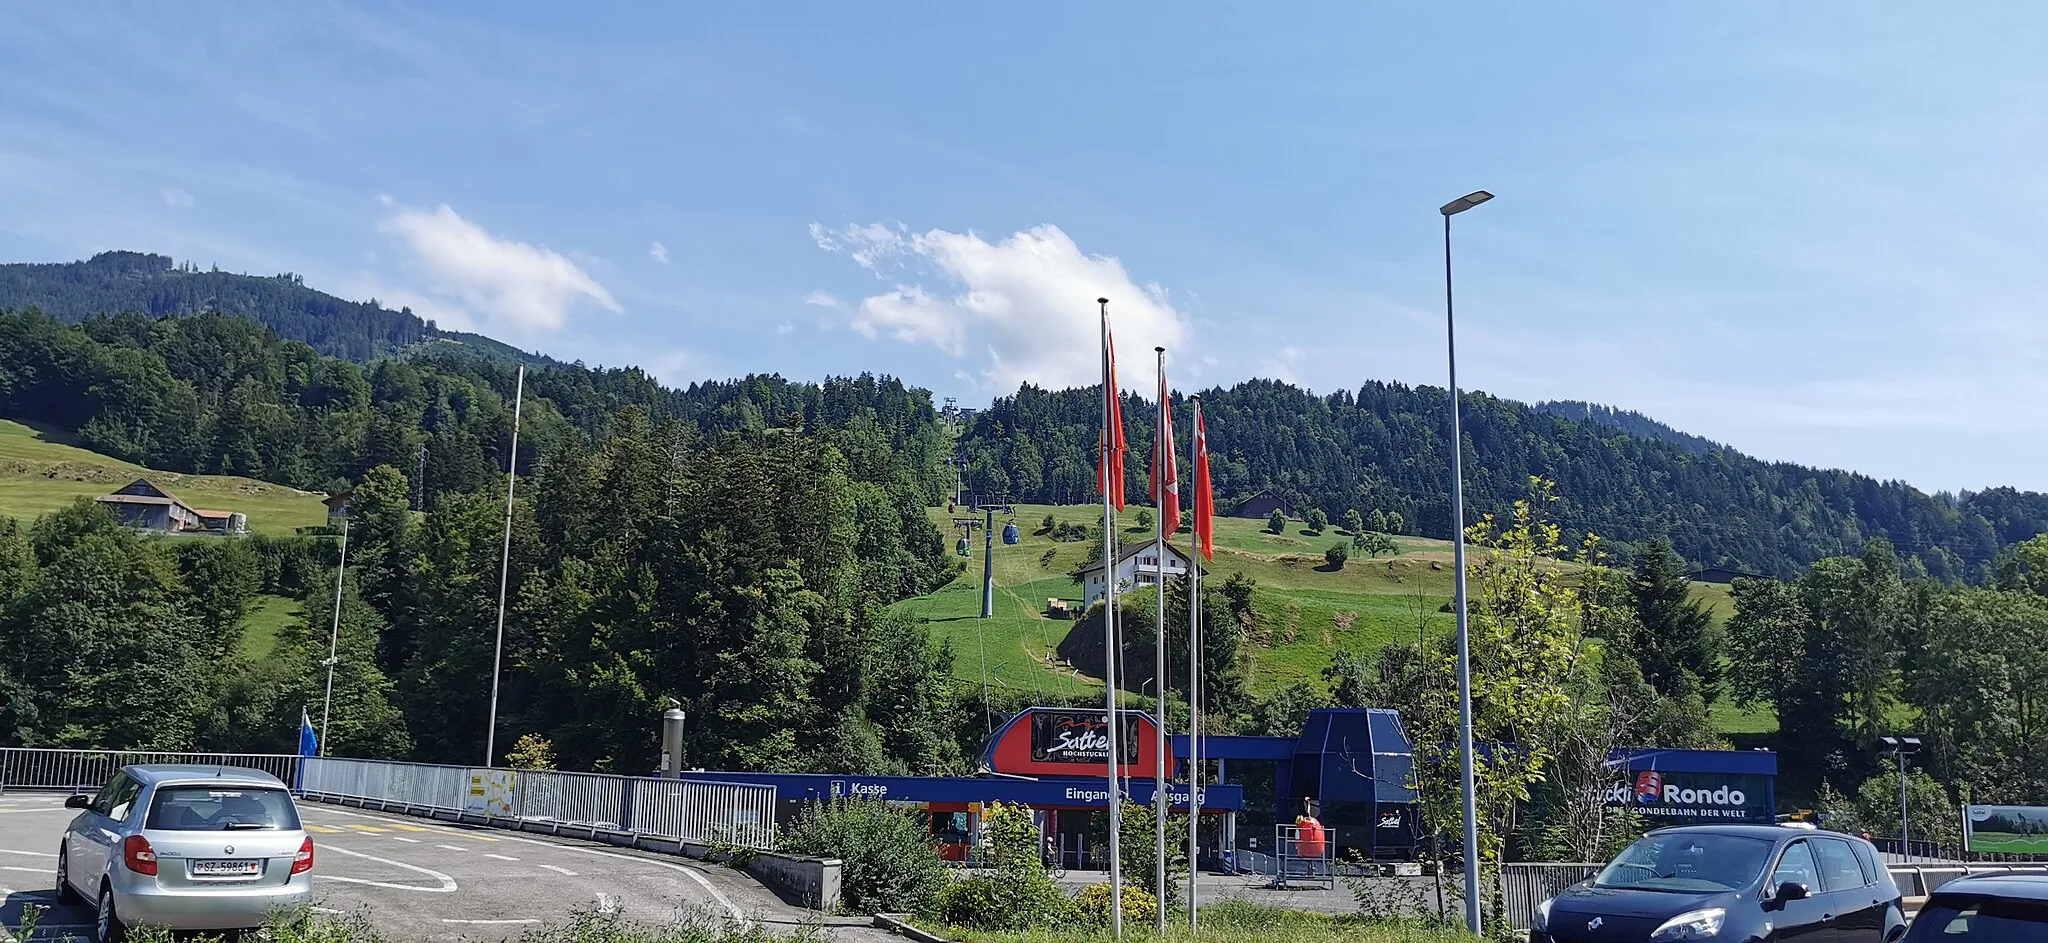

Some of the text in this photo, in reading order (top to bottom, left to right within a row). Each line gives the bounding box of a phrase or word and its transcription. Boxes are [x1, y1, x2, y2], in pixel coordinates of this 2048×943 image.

[1047, 730, 1109, 753] Satte
[851, 782, 887, 794] Kasse
[1066, 788, 1110, 802] Eingan
[1663, 784, 1745, 806] Rondo
[1150, 790, 1206, 805] Asgag
[1700, 808, 1720, 817] DER
[1721, 809, 1746, 818] WELT
